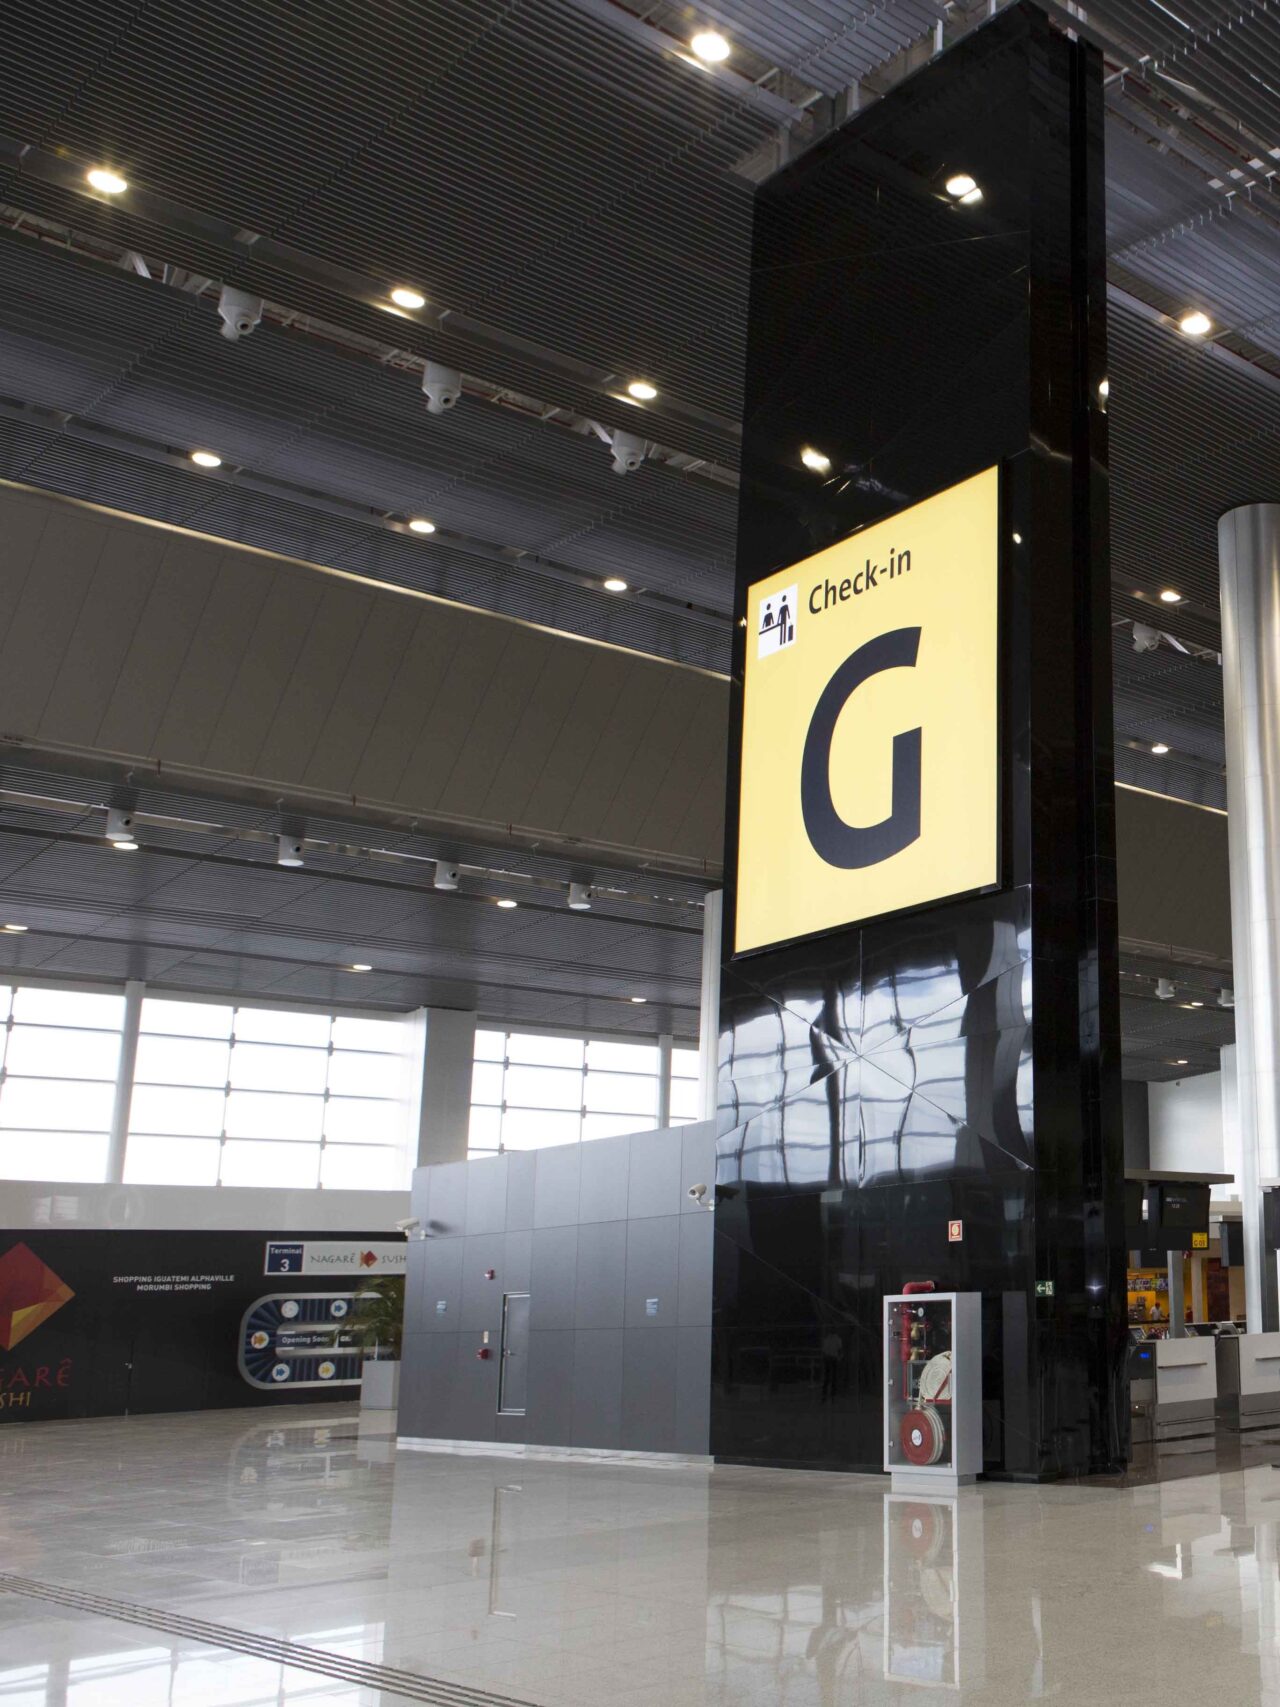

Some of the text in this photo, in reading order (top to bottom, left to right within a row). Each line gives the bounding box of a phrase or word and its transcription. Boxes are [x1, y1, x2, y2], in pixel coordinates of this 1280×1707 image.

[808, 547, 912, 615] Check-in
[801, 626, 922, 870] G
[270, 1247, 302, 1255] Terminal
[280, 1258, 290, 1272] 3
[281, 1335, 311, 1344] Opening
